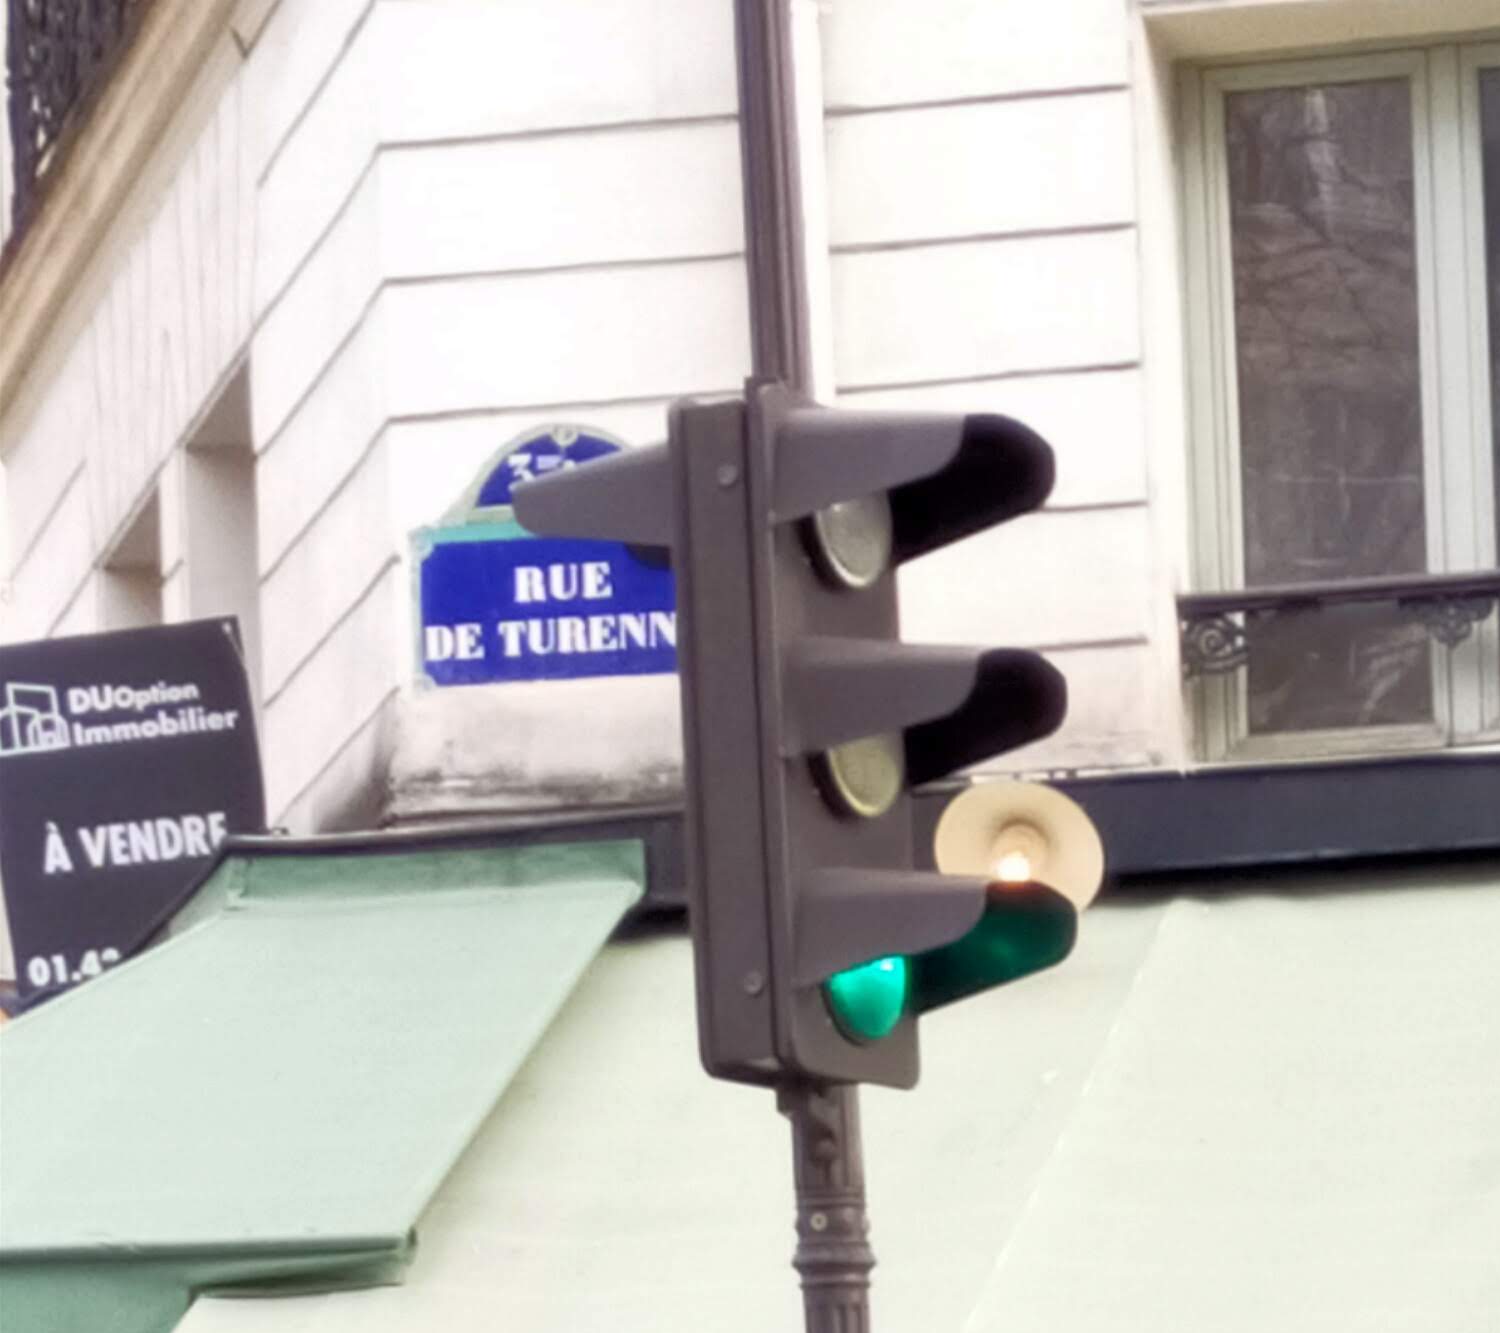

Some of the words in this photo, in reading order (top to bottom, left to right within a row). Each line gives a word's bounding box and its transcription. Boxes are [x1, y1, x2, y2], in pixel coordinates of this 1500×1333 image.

[514, 562, 613, 603] RUE
[425, 624, 485, 661] DE
[498, 612, 677, 658] TURENN
[67, 681, 199, 714] DUOption
[72, 707, 239, 746] Immobilier
[43, 821, 73, 874] À
[79, 812, 229, 868] VENDRE
